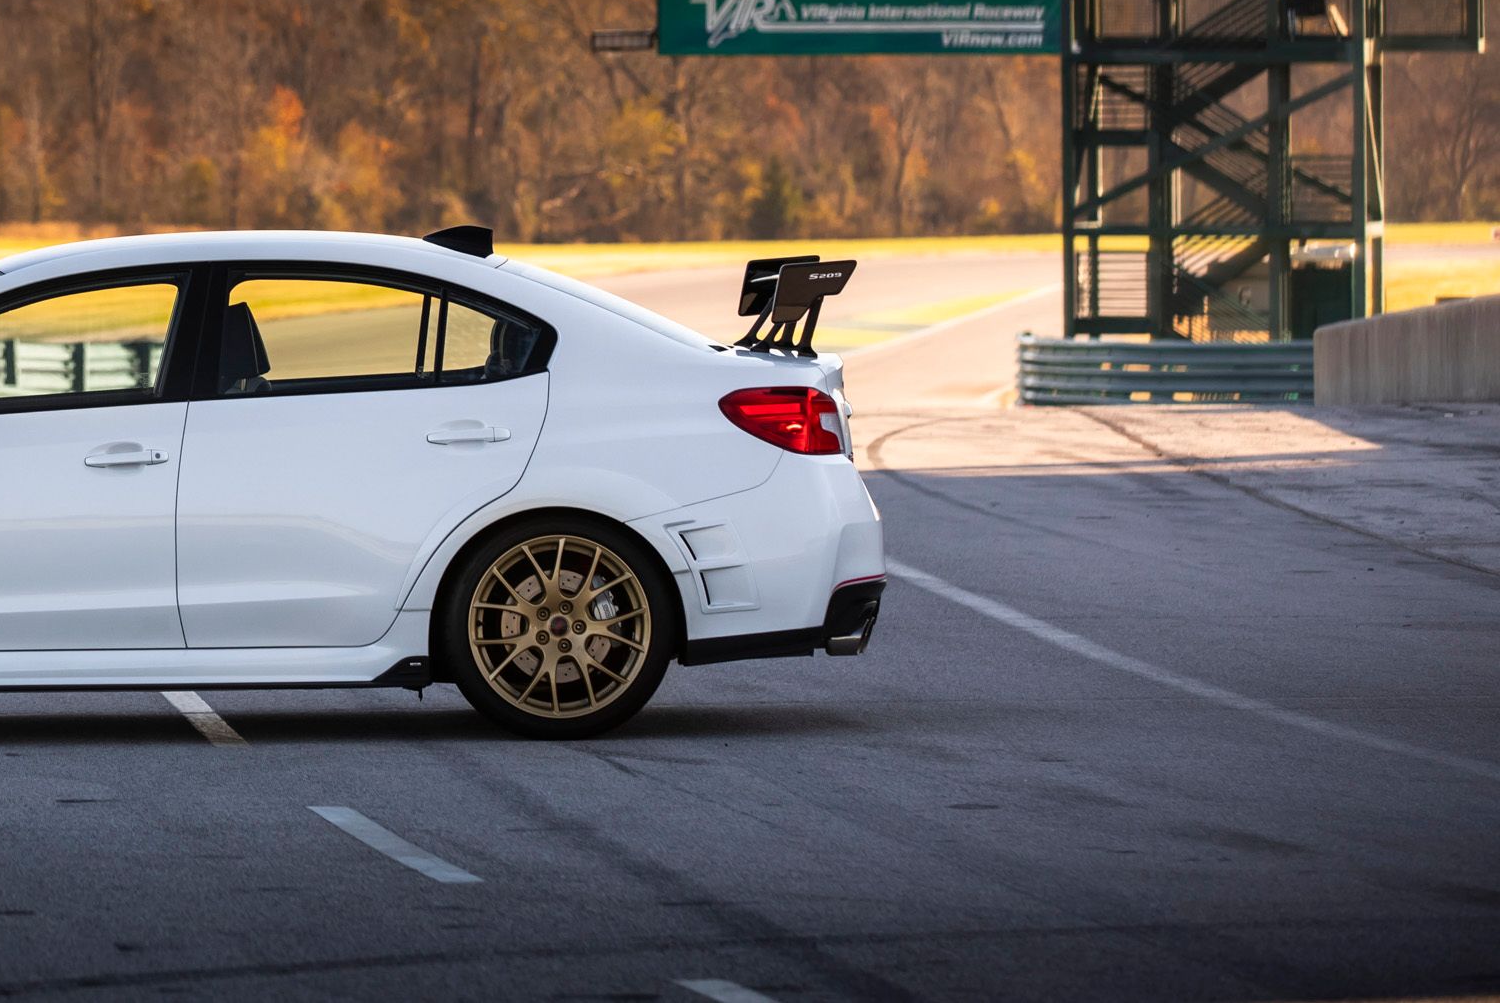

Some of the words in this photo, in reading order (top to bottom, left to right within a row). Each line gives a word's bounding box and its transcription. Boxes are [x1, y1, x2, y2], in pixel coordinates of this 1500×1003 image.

[868, 3, 971, 20] International
[973, 3, 1045, 22] Raceway
[809, 272, 842, 280] S209
